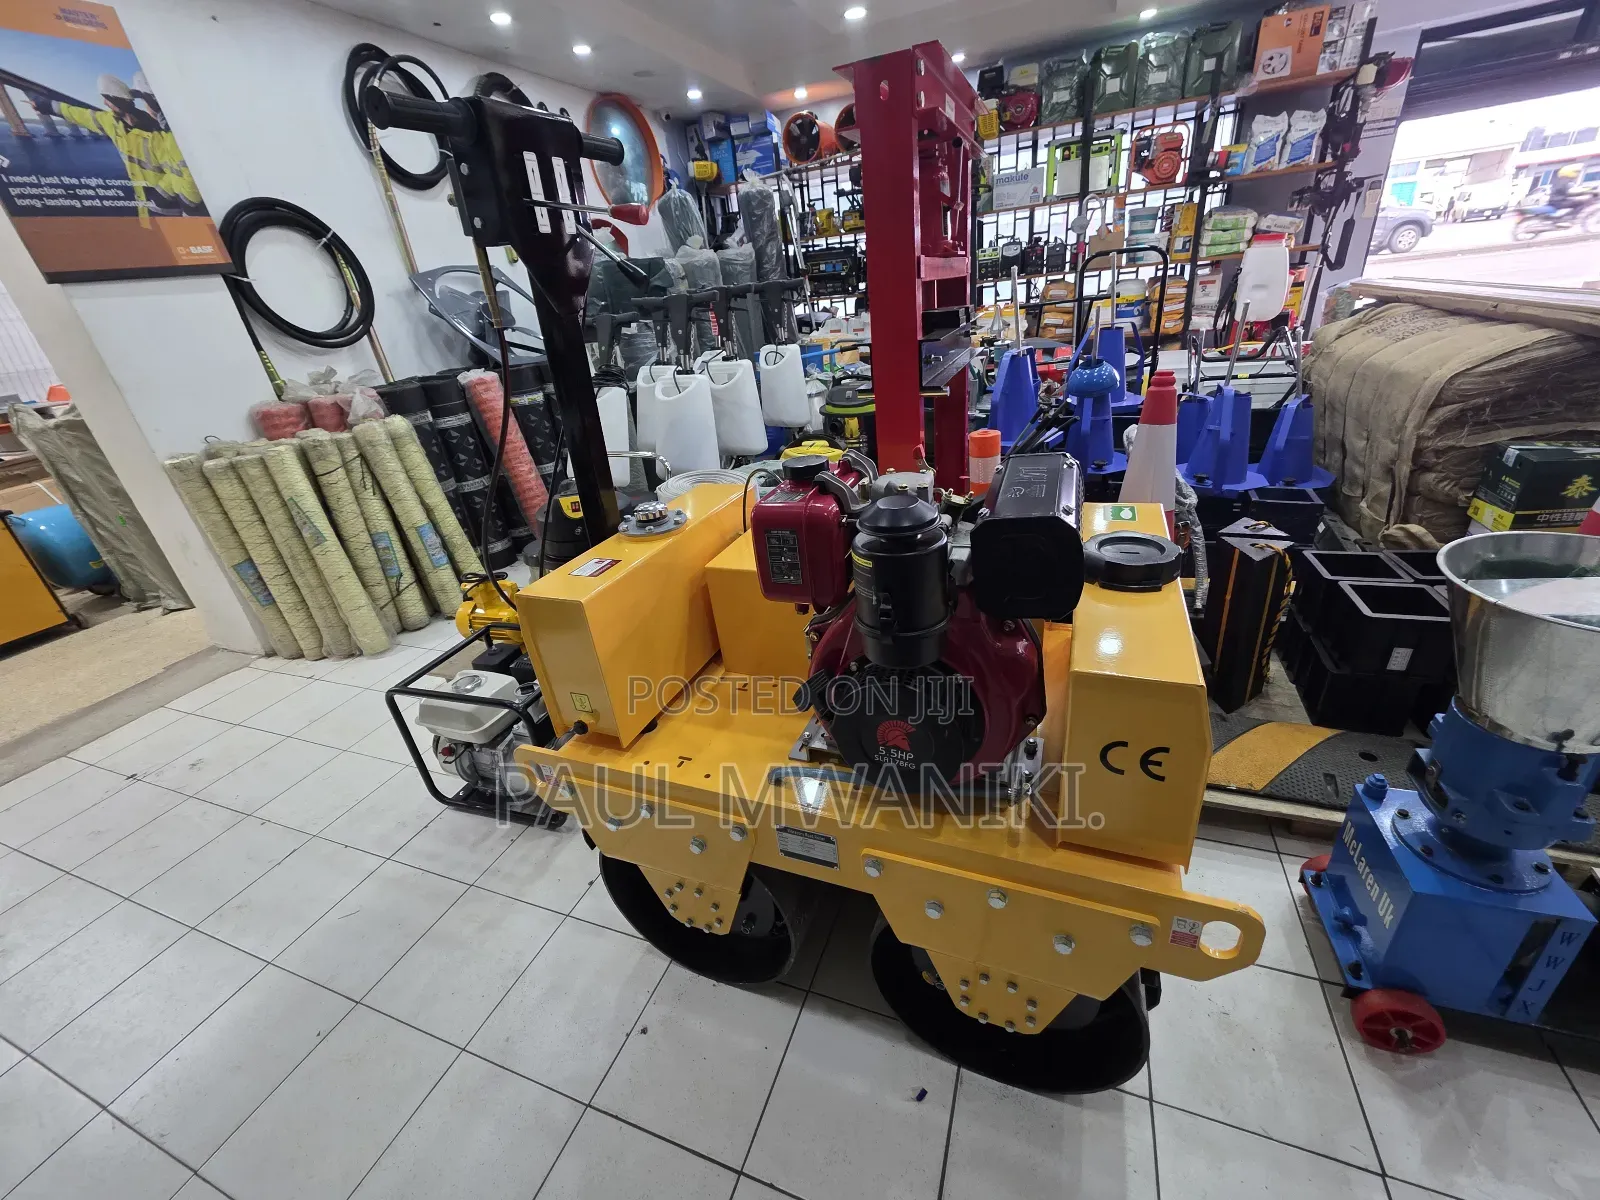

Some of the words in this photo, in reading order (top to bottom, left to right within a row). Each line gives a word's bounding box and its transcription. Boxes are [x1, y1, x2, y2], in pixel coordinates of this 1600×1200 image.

[9, 175, 38, 183] need
[39, 175, 61, 185] just
[60, 176, 79, 184] the
[80, 178, 105, 187] right
[995, 172, 1029, 185] makute
[8, 186, 66, 196] protection
[76, 188, 96, 196] one
[14, 198, 81, 208] long-lasting
[878, 746, 914, 761] 5.5HP
[1342, 820, 1380, 904] McLaren
[1377, 891, 1395, 930] Uk
